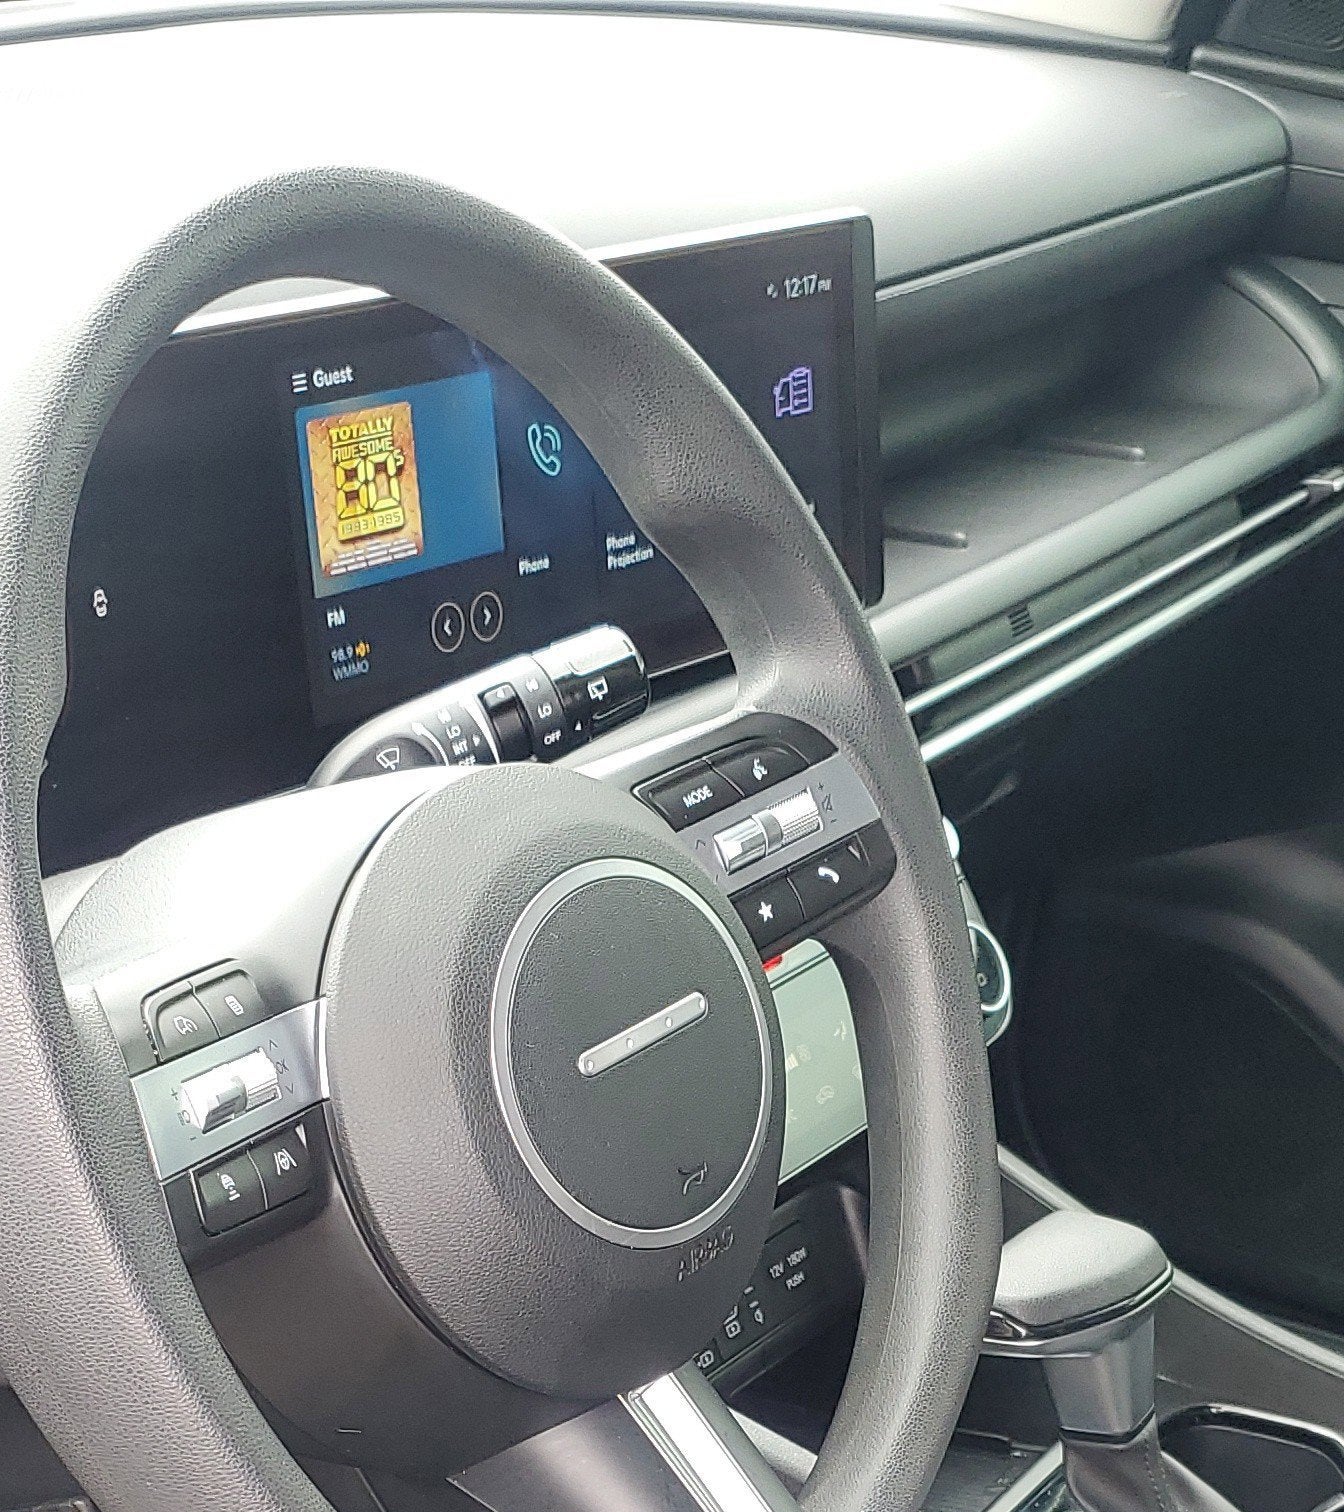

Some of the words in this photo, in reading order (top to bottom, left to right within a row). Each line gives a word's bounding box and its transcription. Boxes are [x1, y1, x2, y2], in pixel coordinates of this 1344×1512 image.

[313, 366, 354, 388] Guest
[329, 416, 394, 442] TOTALLY
[332, 437, 395, 463] AWESOME
[606, 531, 635, 551] Phone
[518, 554, 550, 576] Phone
[607, 545, 654, 570] Projection
[327, 606, 346, 628] FM
[537, 703, 553, 719] LO
[544, 730, 562, 745] OFF
[682, 785, 714, 808] MODE
[769, 1262, 784, 1279] 12V
